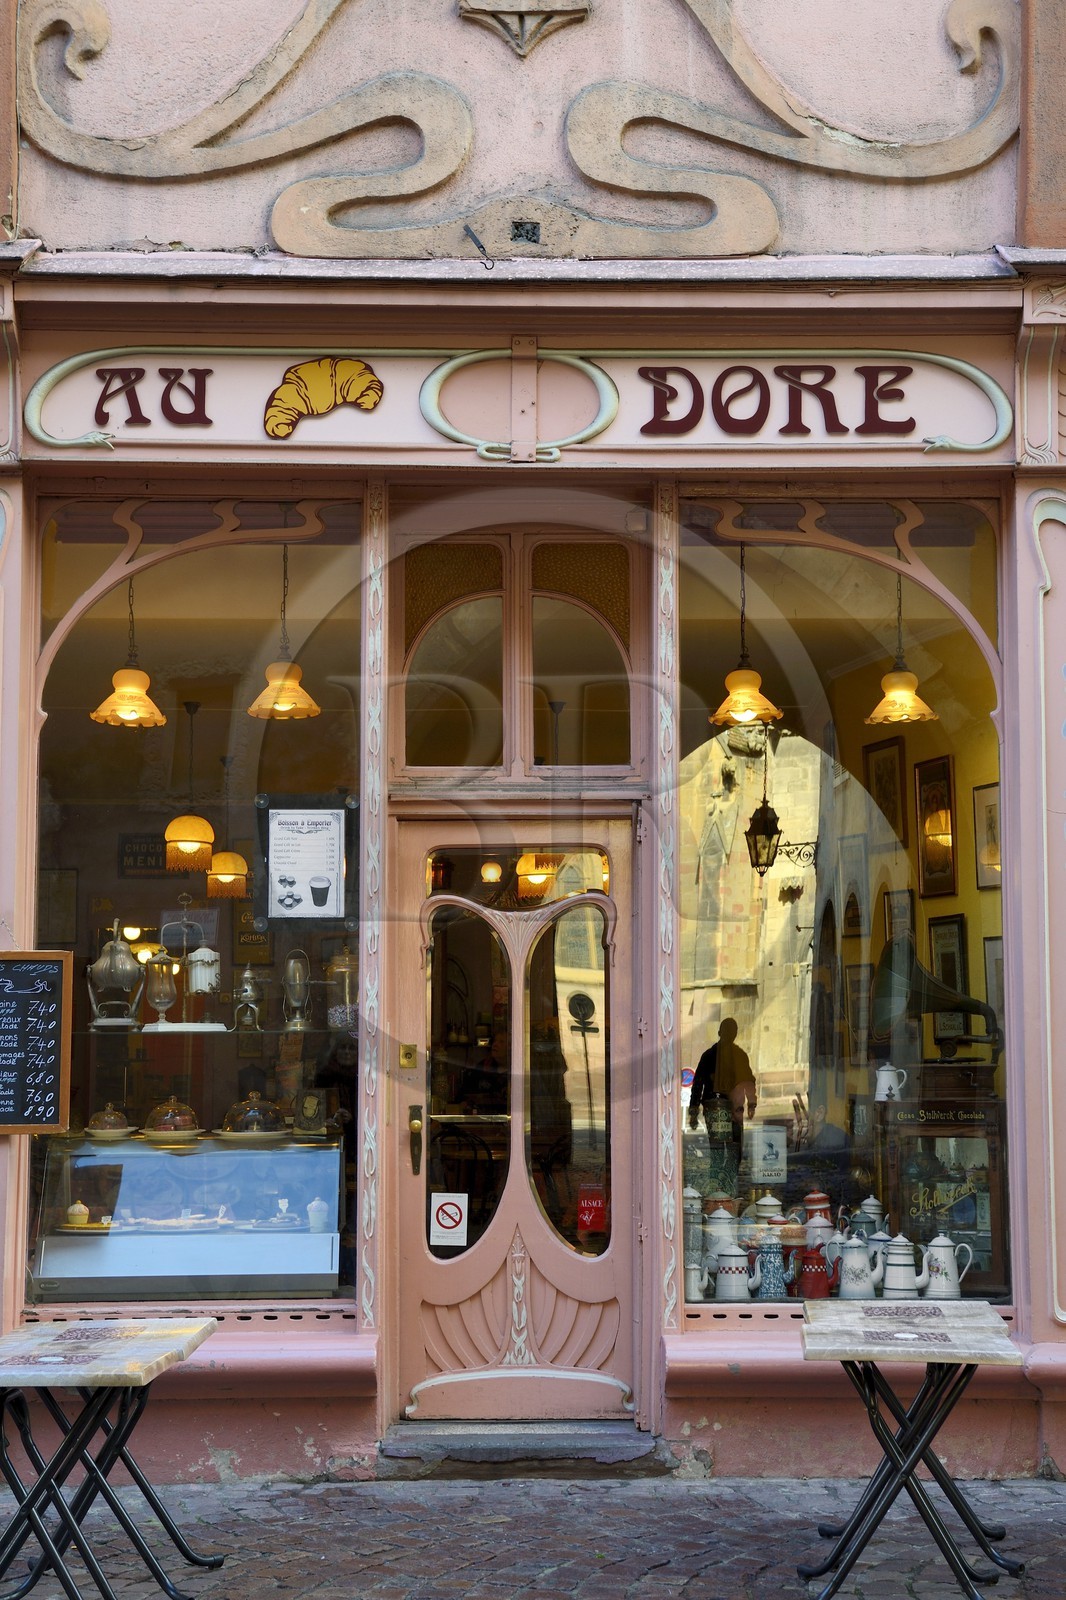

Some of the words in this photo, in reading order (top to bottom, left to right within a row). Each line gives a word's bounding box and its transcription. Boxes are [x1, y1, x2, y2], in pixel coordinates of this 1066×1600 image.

[94, 368, 214, 426] AU
[637, 365, 917, 435] DORE
[123, 855, 163, 867] MENI
[581, 1199, 603, 1208] ALSACE
